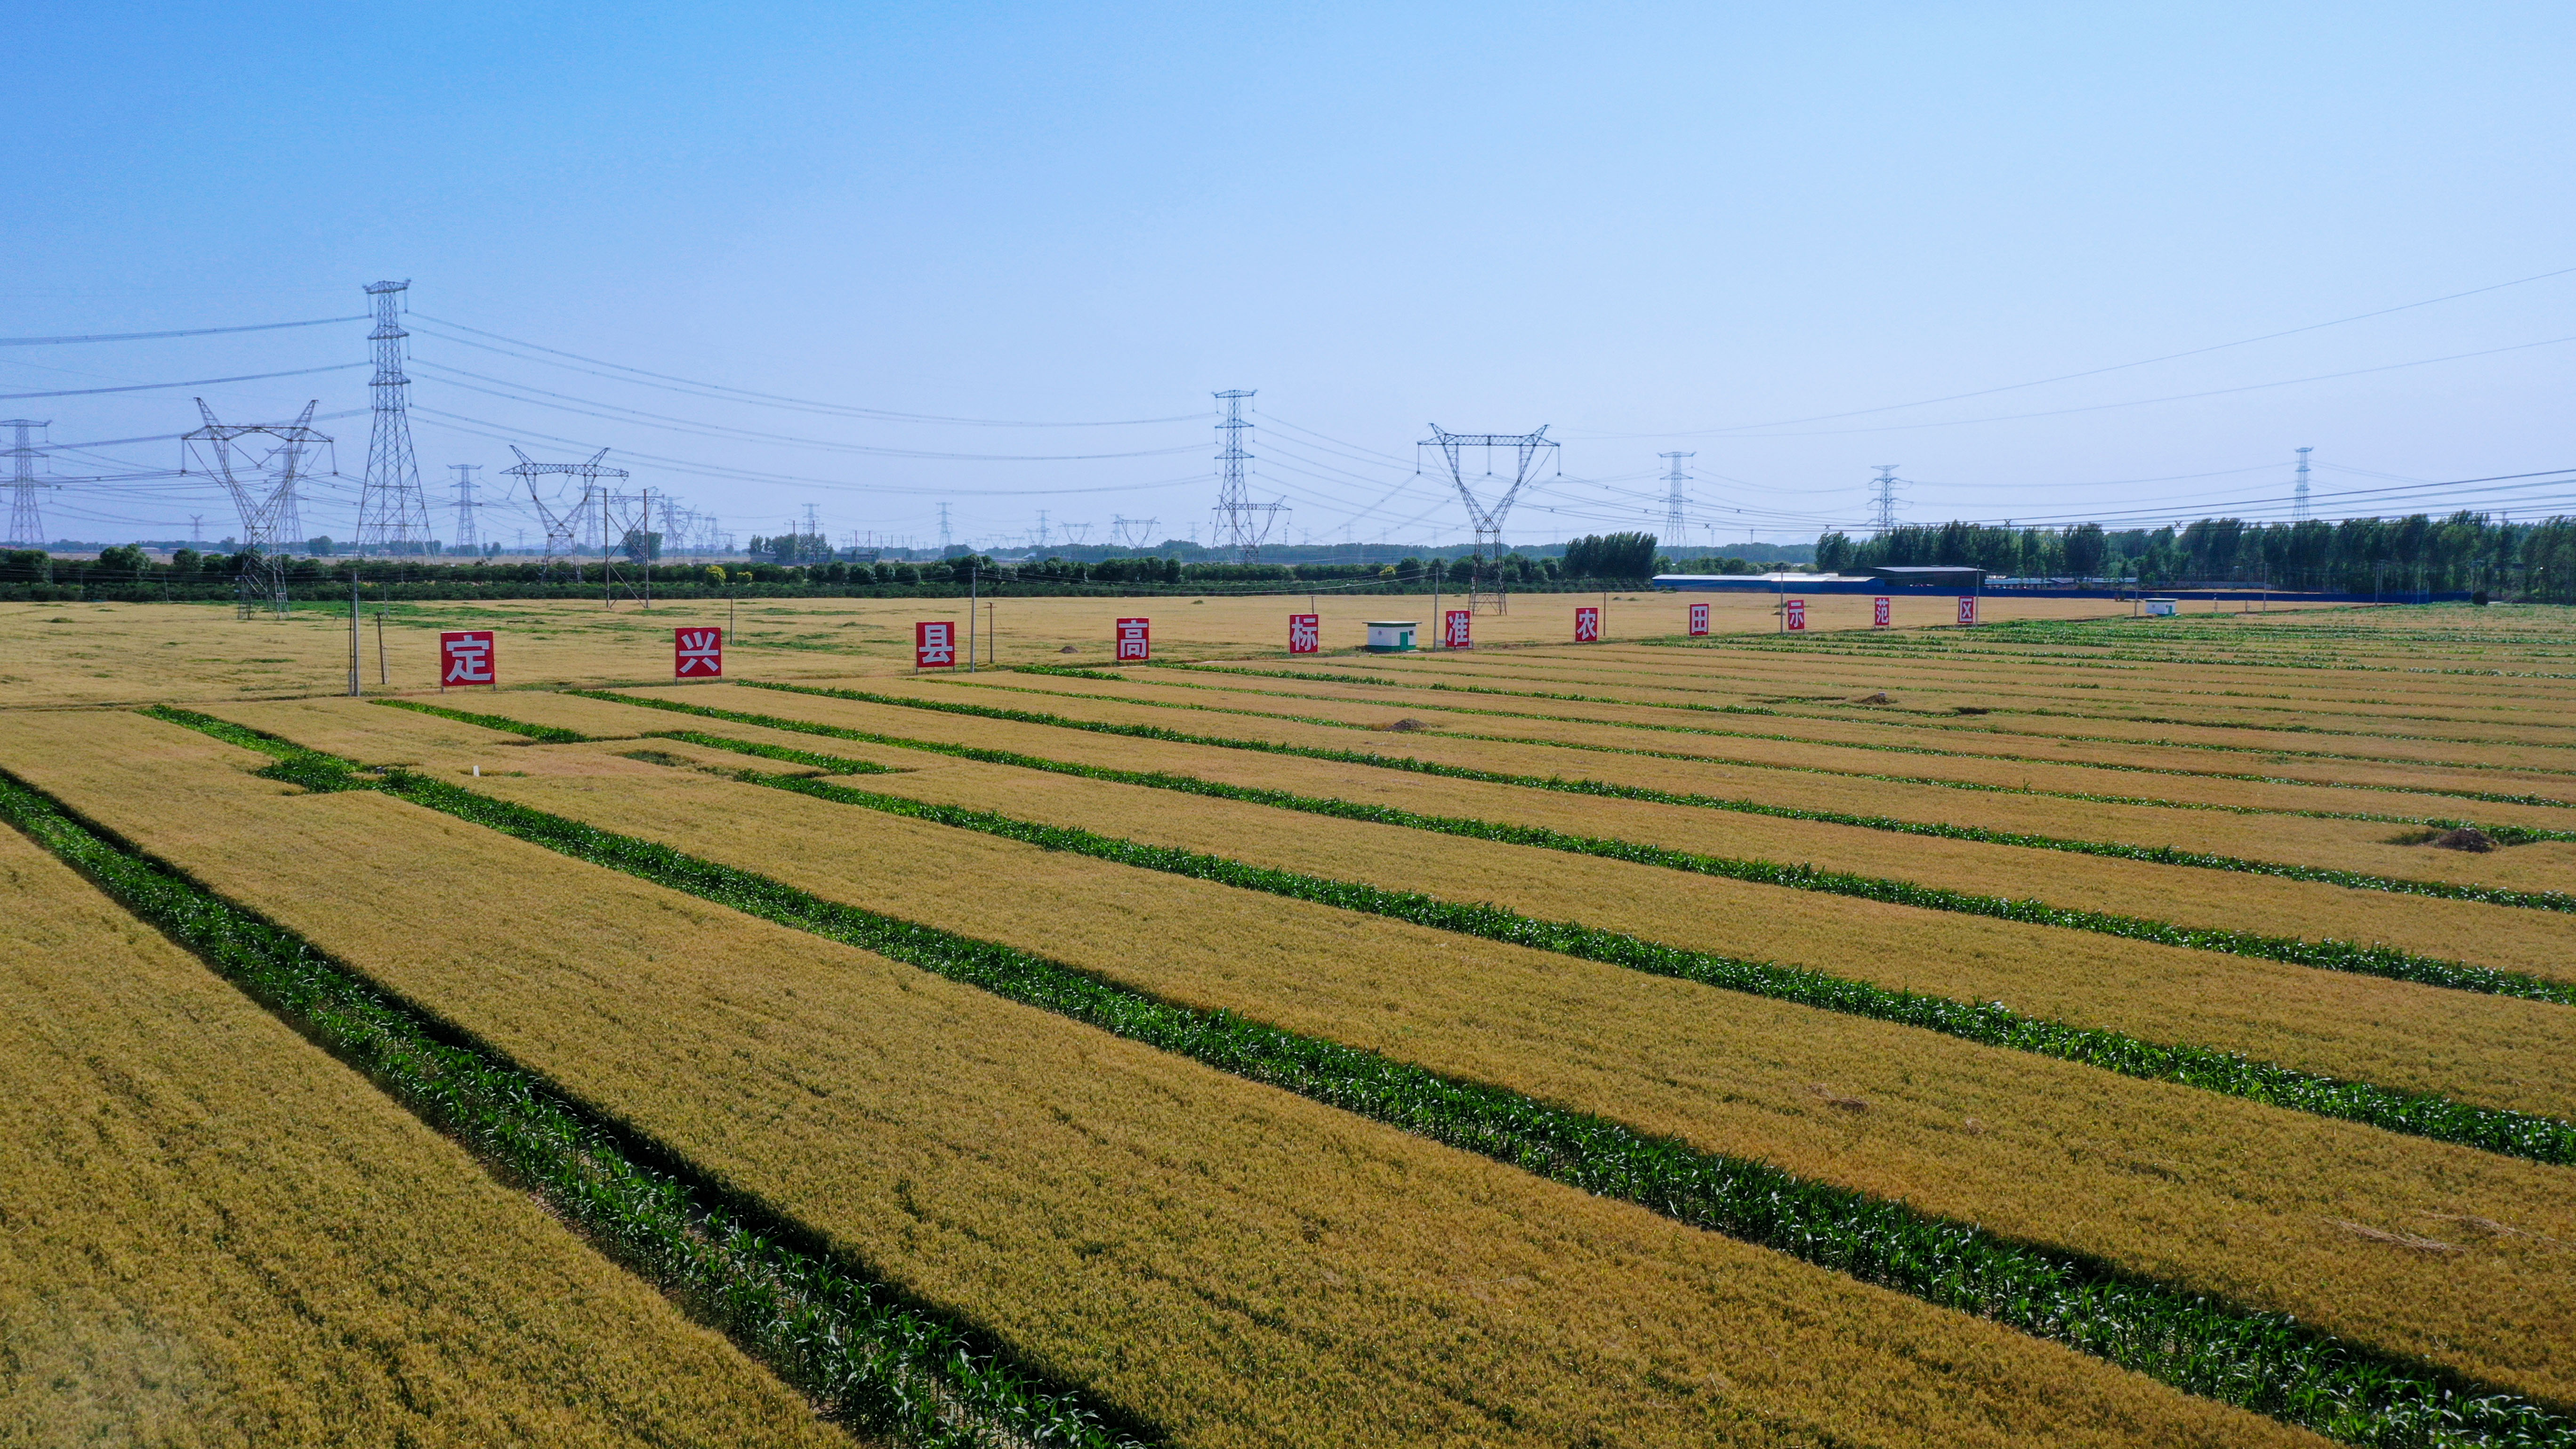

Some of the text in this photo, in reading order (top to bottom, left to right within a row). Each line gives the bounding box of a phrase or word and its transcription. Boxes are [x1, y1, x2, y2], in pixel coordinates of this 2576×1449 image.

[446, 598, 1973, 683] 定 兴 县 高 标 准 农 田 示 范 区
